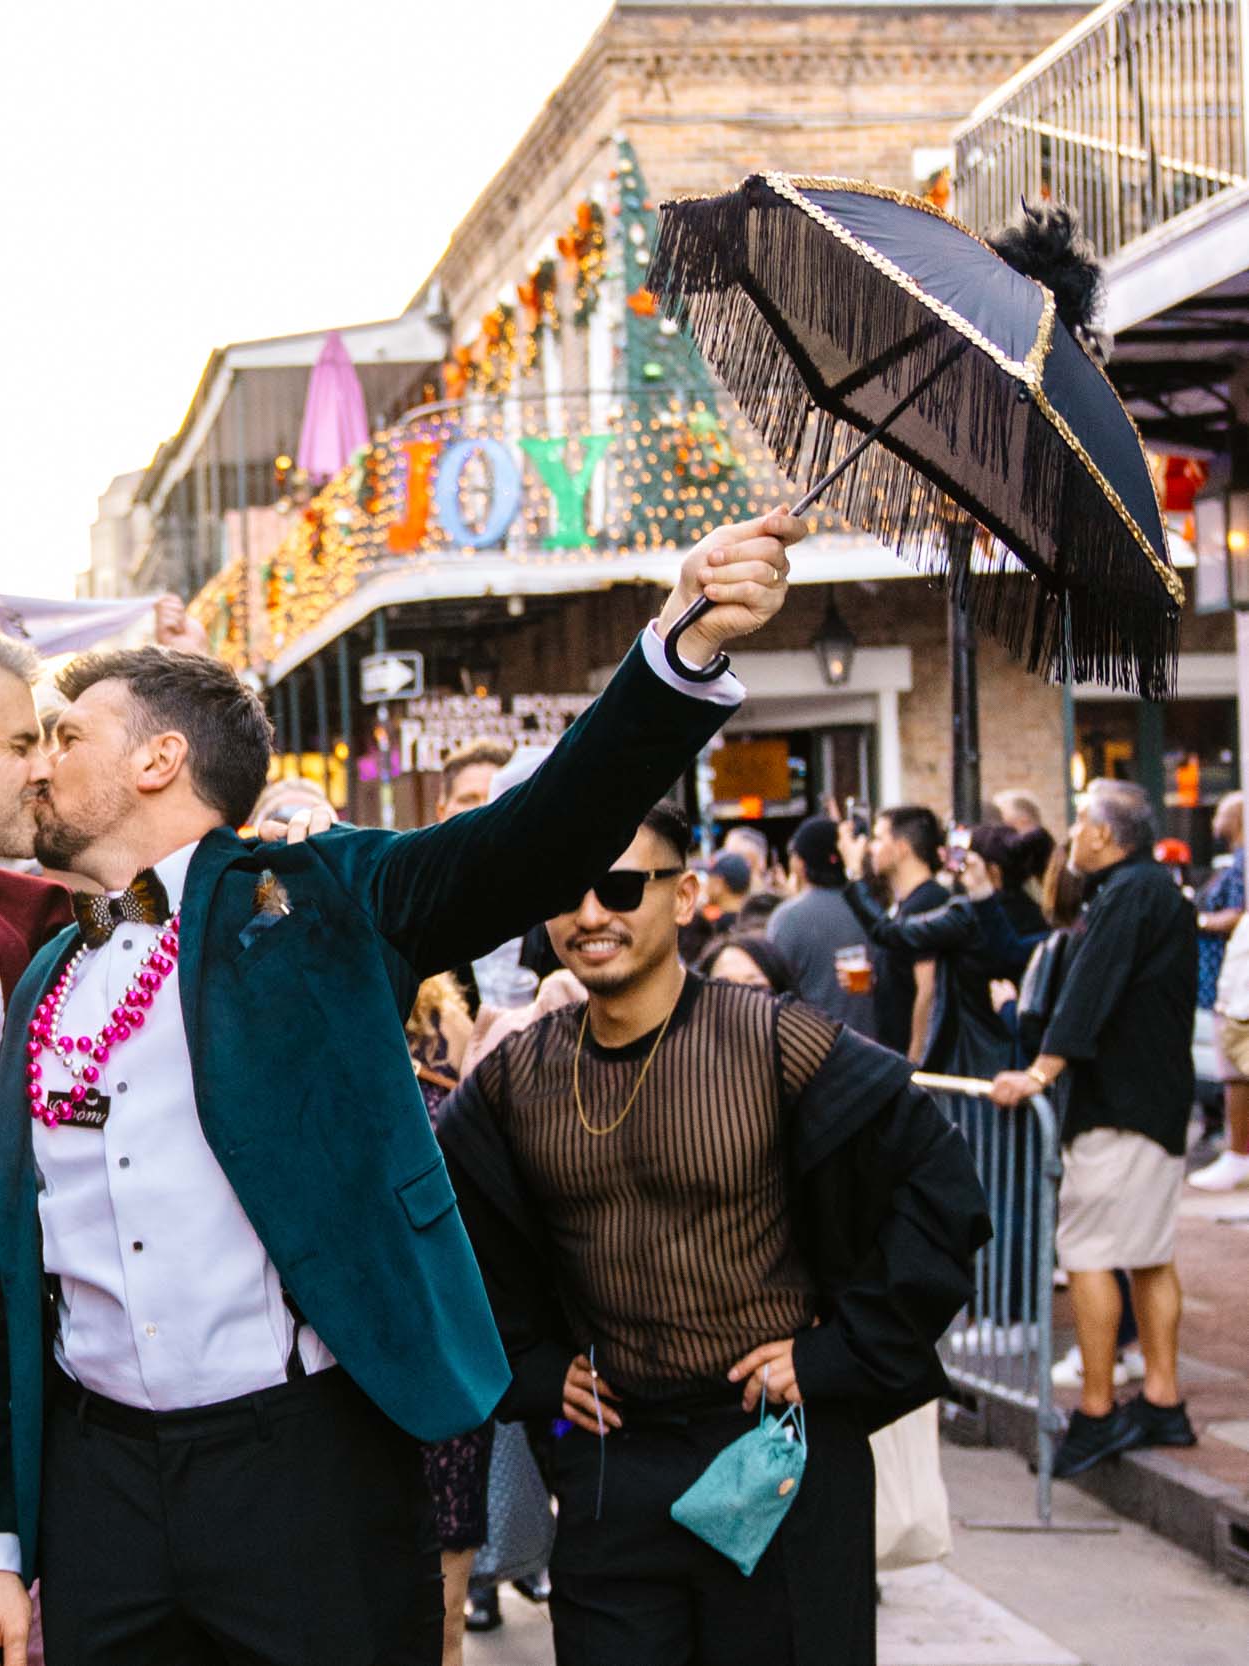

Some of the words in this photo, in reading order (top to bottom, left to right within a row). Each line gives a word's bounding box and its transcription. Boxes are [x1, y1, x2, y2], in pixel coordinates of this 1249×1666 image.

[387, 434, 616, 554] JOY
[407, 695, 502, 717] MAISON
[48, 1099, 107, 1124] Gom
